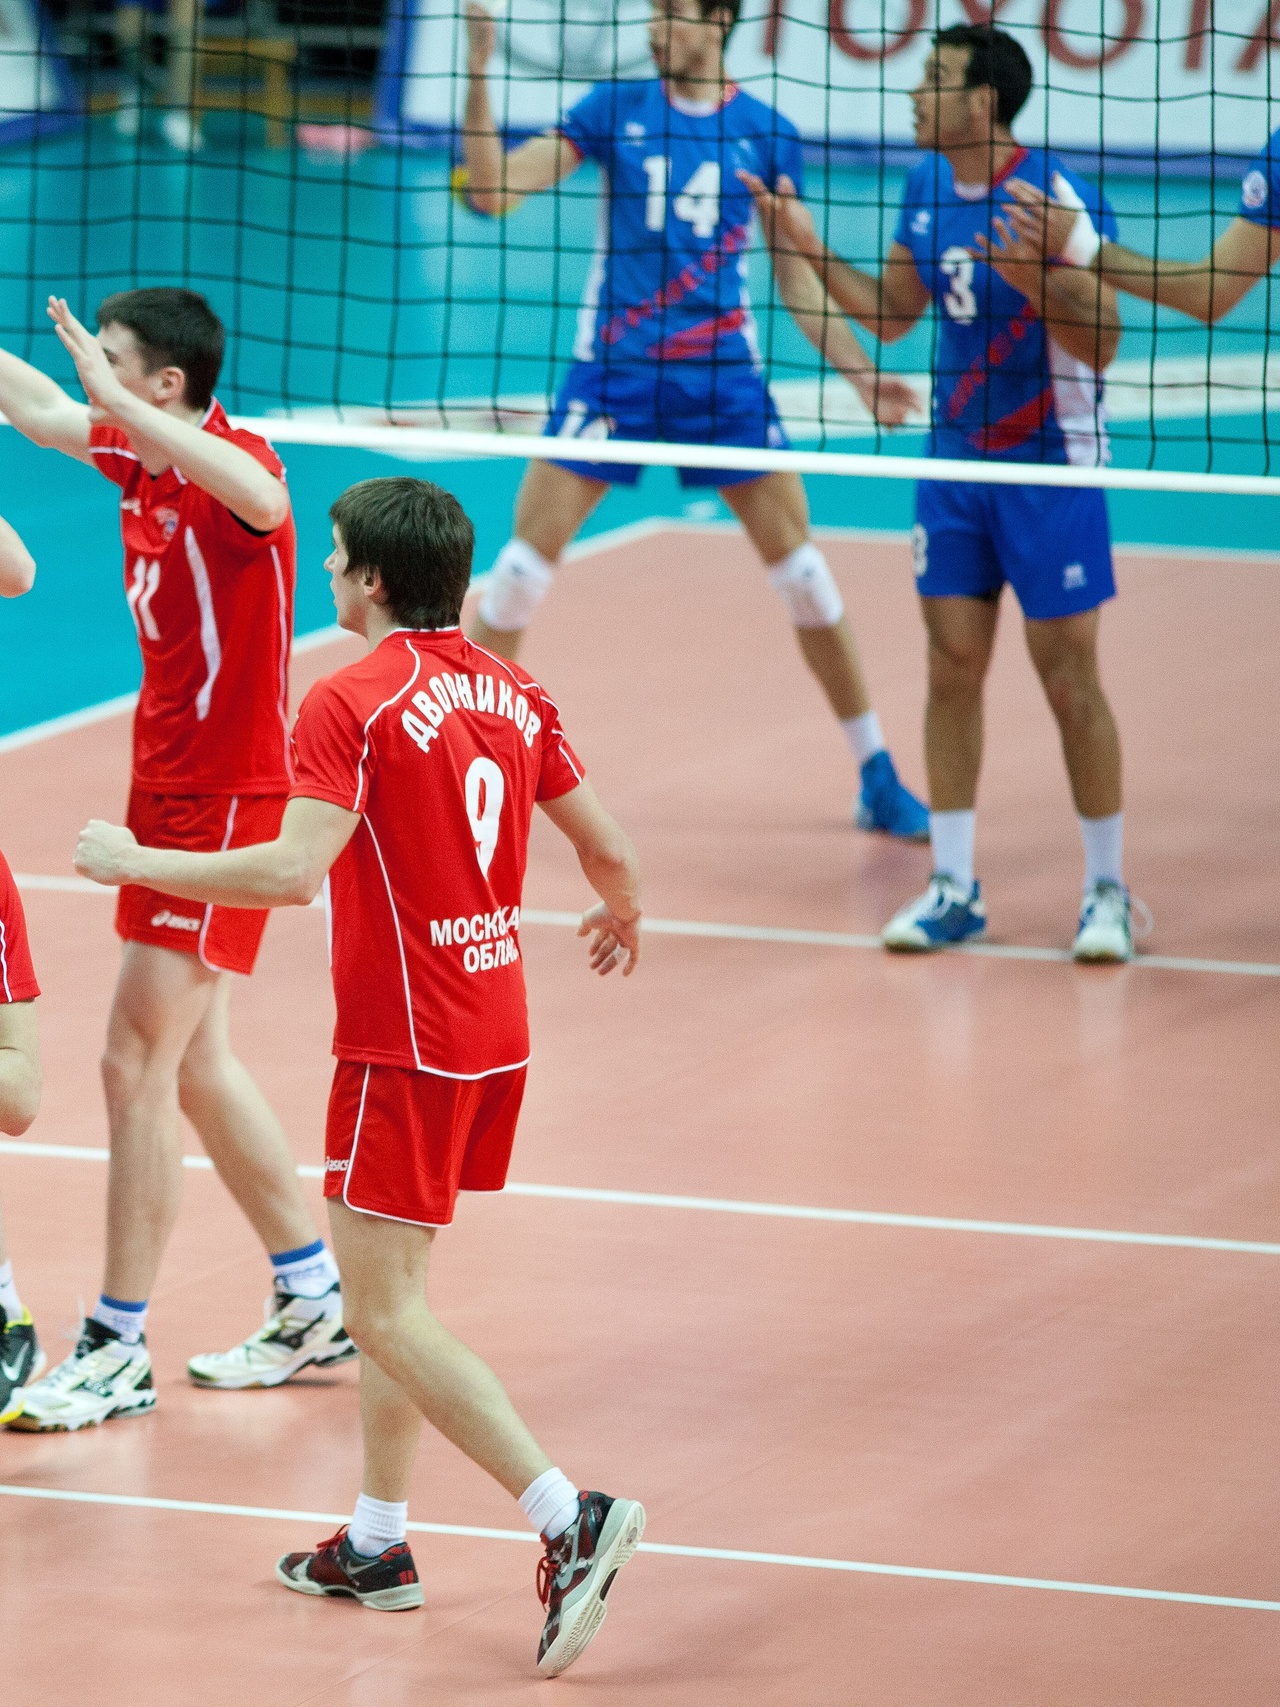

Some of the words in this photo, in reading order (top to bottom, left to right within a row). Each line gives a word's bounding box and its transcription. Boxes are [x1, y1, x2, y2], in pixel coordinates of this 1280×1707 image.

[642, 154, 720, 239] 14
[940, 246, 978, 325] 3
[401, 672, 542, 754] ДВОРНИКОВ
[465, 756, 504, 882] 9
